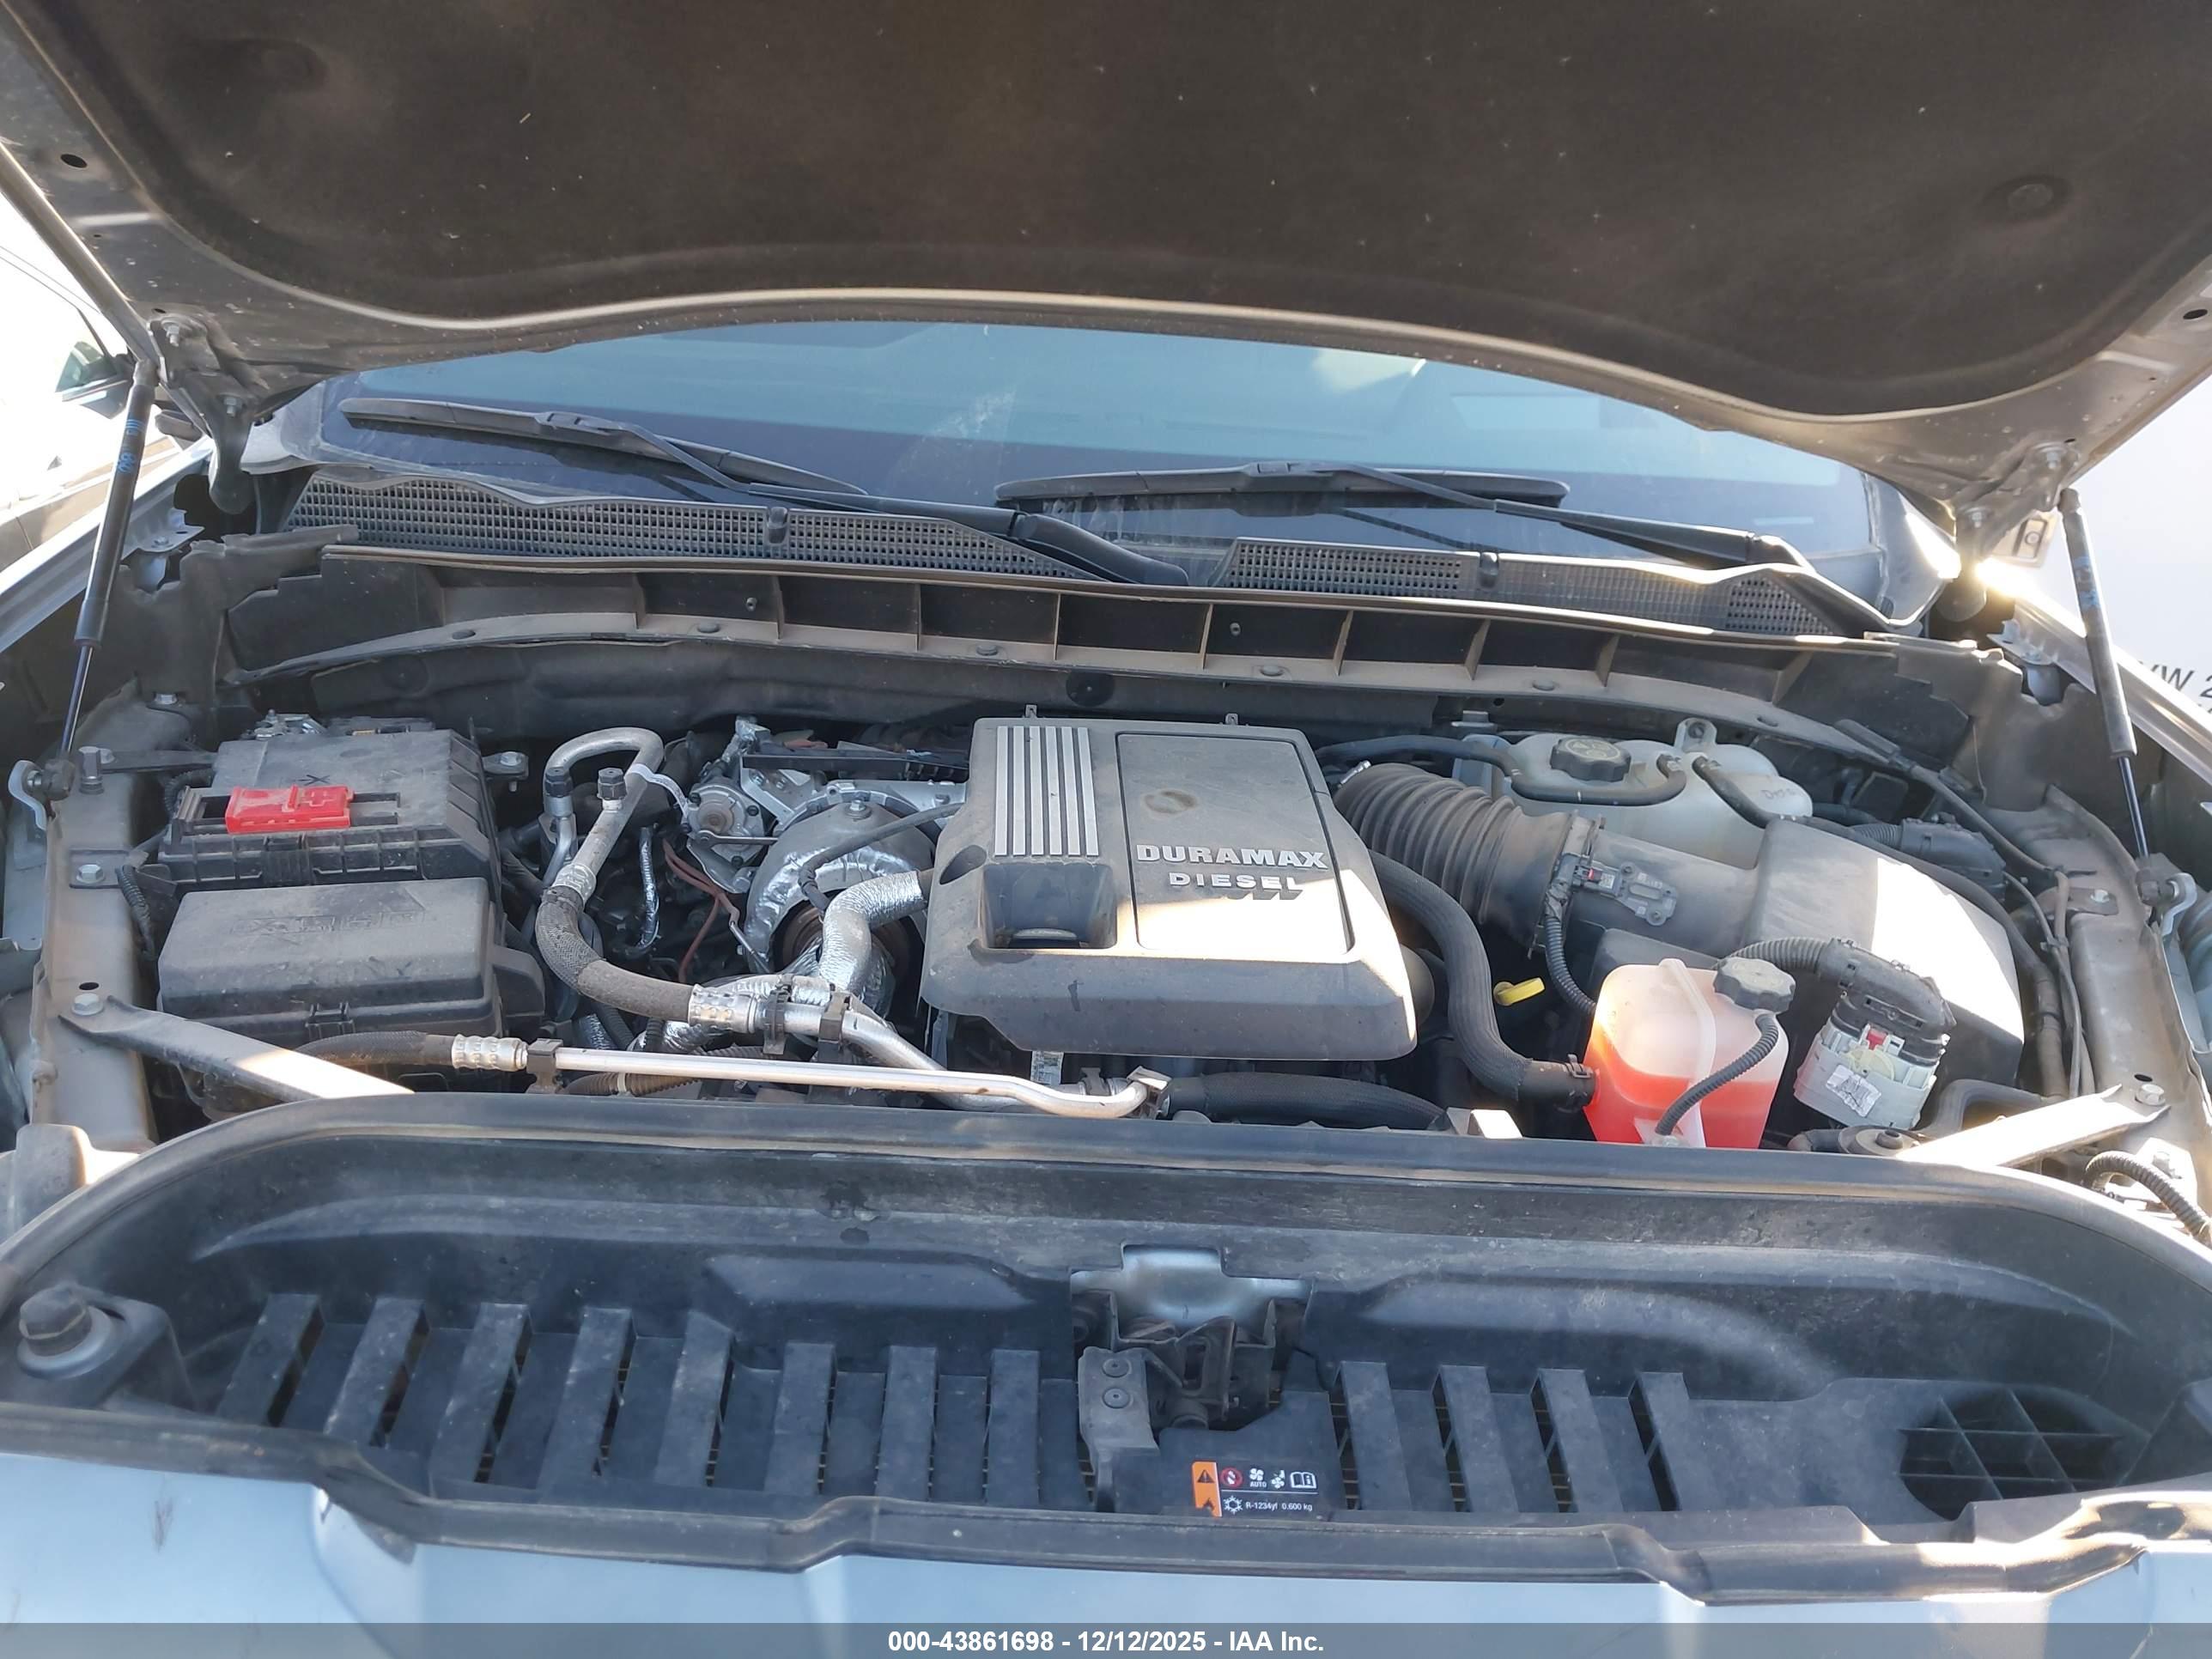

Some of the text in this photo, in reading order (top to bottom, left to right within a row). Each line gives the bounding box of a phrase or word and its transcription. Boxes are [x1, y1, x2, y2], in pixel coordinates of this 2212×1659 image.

[1136, 844, 1328, 869] DURAMAX
[1169, 872, 1304, 890] DIESEL
[1245, 1501, 1313, 1512] R-1234yf 0.600 kg
